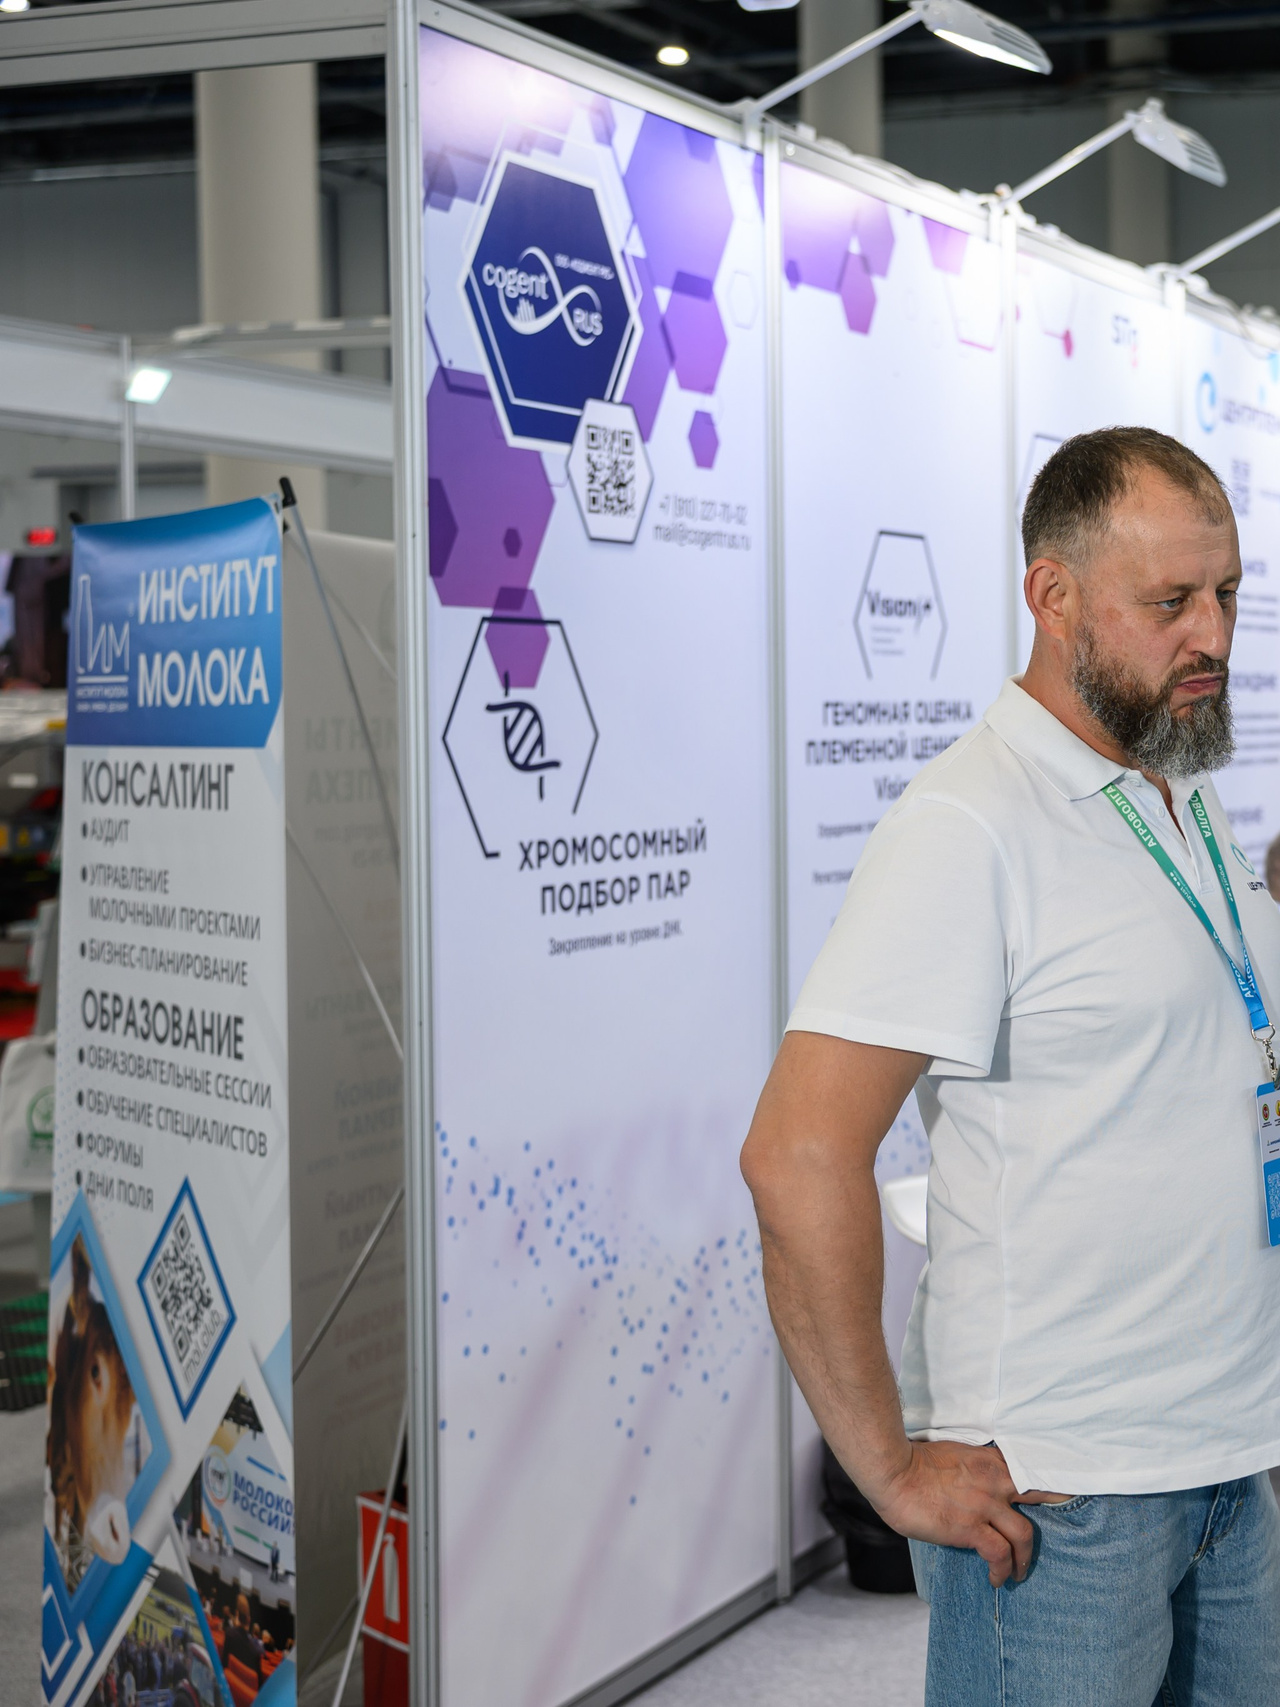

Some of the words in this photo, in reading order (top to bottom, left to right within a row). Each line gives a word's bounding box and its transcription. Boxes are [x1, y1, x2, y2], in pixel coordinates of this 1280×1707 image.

[482, 262, 549, 300] cogent
[573, 307, 603, 336] RUS
[138, 555, 278, 625] ИНСТИТУТ
[137, 646, 270, 708] МОЛОКА
[822, 700, 911, 726] ГЕНОМНАЯ
[914, 700, 974, 727] ОЦЕНКА
[805, 730, 908, 766] ПЛЕМЕННОЙ
[82, 759, 235, 812] КОНСАЛТИНГ
[90, 817, 131, 848] АУДИТ
[1105, 784, 1158, 848] АГРОВОЛГА
[519, 818, 707, 872] ХРОМОСОМНЫЙ
[89, 862, 169, 895] УПРАВЛЕНИЕ
[541, 875, 641, 916] ПОДБОР
[648, 868, 691, 902] ПАР
[89, 896, 176, 932] МОЛОЧНЫМИ
[179, 905, 261, 942] ПРОЕКТАМИ
[89, 937, 248, 987] БИЗНЕС-ПЛАНИРОВАНИЕ
[81, 987, 244, 1062] ОБРАЗОВАНИЕ
[87, 1044, 212, 1096] ОБРАЗОВАТЕЛЬНЫЕ
[214, 1073, 272, 1110] СЕССИИ
[86, 1088, 154, 1128] ОБУЧЕНИЕ
[156, 1106, 268, 1158] СПЕЦИАЛИСТОВ
[86, 1132, 143, 1169] ФОРУМЫ
[86, 1170, 115, 1200] ДНИ
[117, 1178, 154, 1213] ПОЛЯ
[232, 1489, 292, 1535] РОССИИ
[233, 1470, 294, 1517] МОЛОКО
